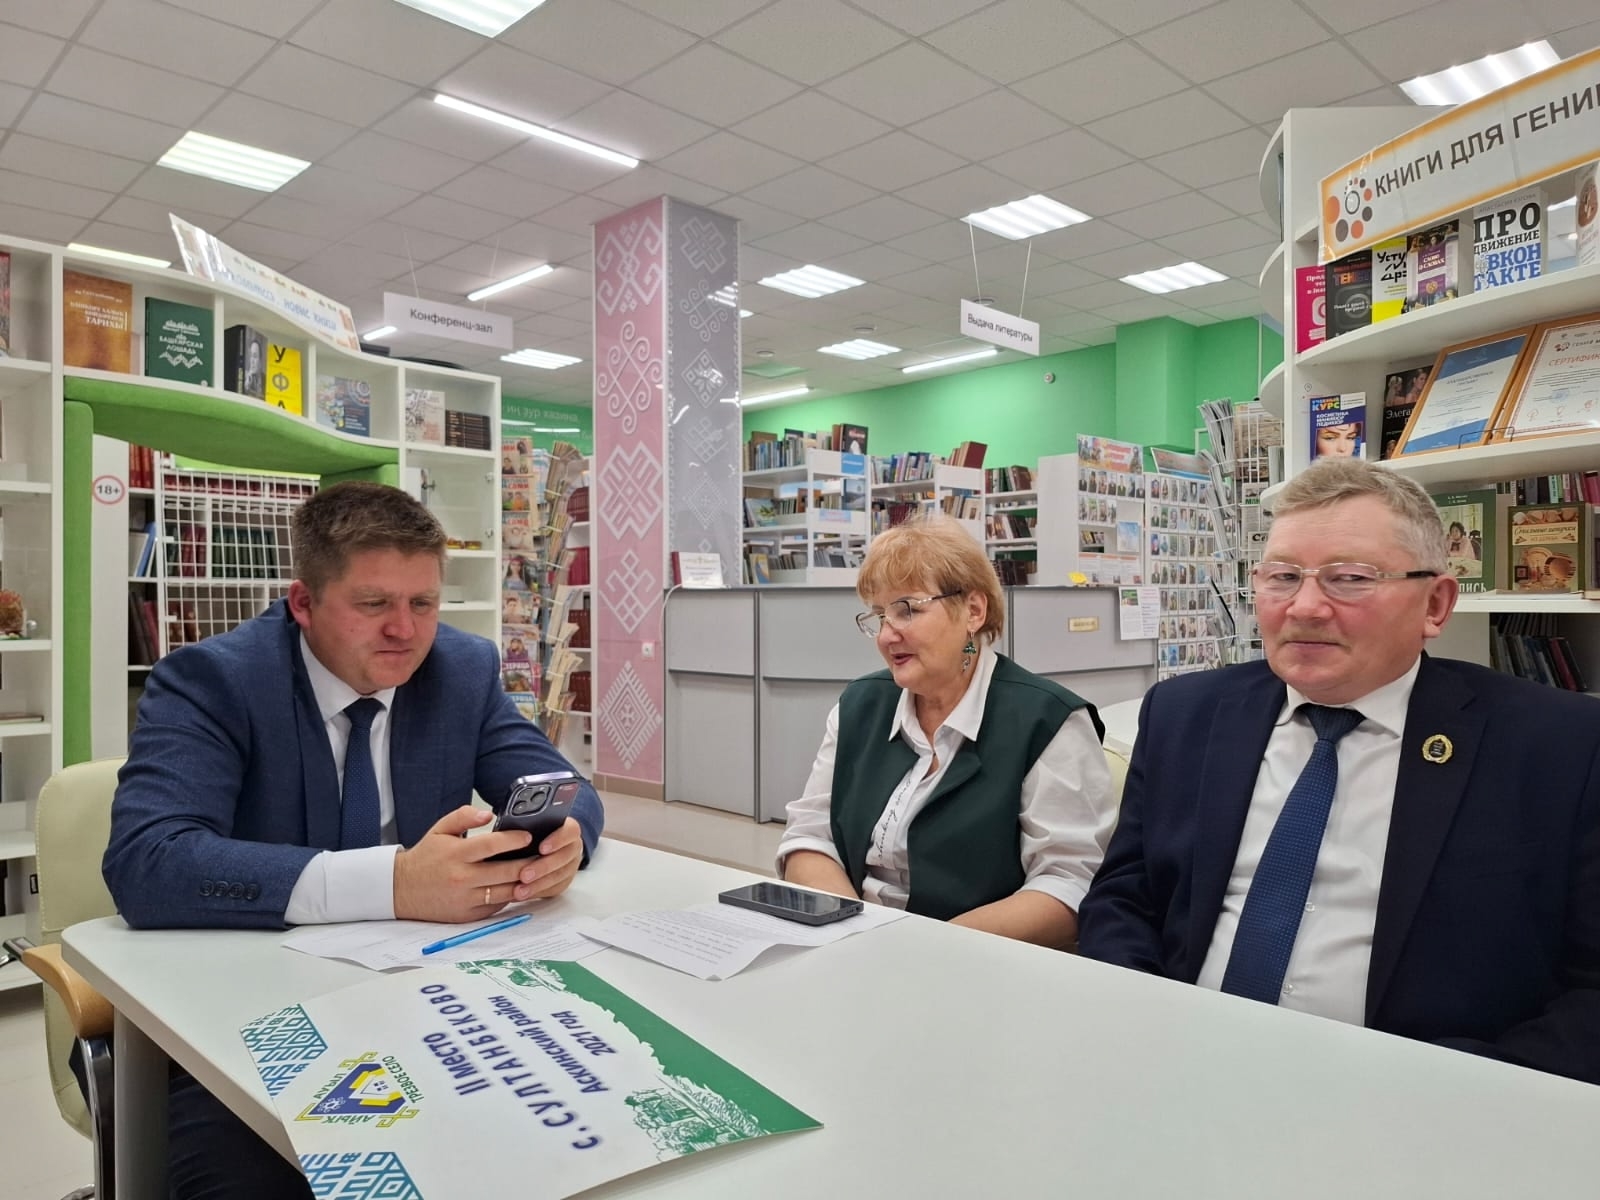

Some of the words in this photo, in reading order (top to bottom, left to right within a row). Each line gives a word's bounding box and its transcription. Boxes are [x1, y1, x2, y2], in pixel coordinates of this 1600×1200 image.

[1375, 150, 1443, 197] КНИГИ
[1450, 123, 1504, 169] ДЛЯ
[1473, 202, 1541, 244] ПРО
[1473, 229, 1540, 255] ДВИЖЕНИЕ
[410, 308, 493, 334] Конференц-зал
[967, 312, 994, 331] Выдача
[995, 324, 1033, 342] литературы
[1312, 401, 1340, 412] КУРС
[96, 484, 121, 495] 18+
[488, 995, 543, 1028] район
[550, 1010, 585, 1031] год
[423, 1032, 480, 1081] место
[570, 1031, 619, 1057] 2021
[516, 1026, 610, 1094] Аскинский
[454, 1077, 492, 1096] II
